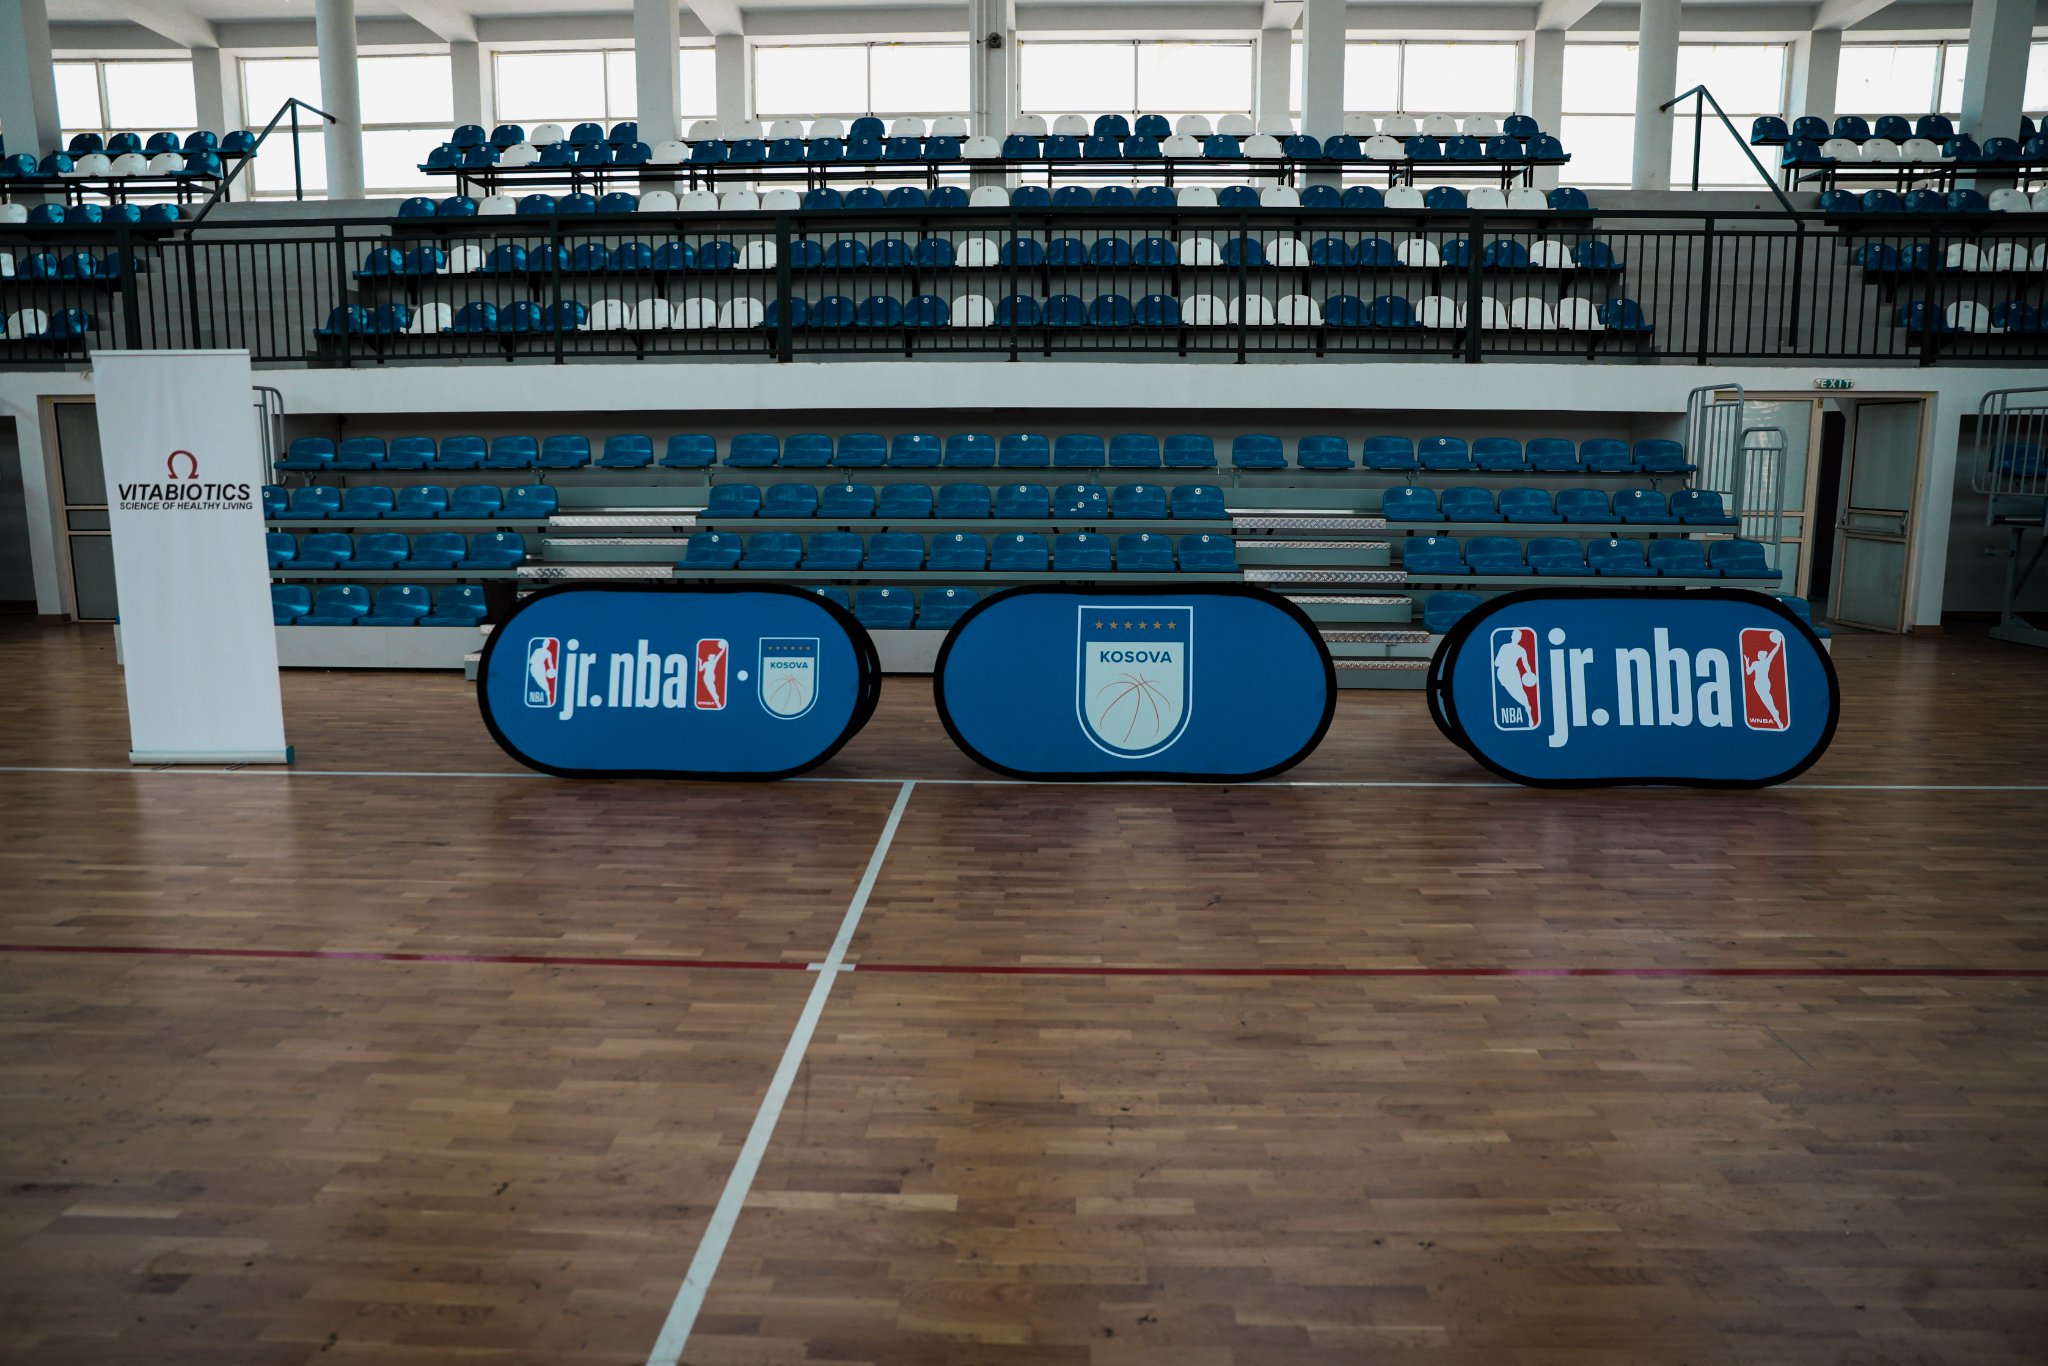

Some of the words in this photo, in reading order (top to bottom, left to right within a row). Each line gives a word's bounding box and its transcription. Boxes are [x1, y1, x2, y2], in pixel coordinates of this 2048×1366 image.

[1821, 380, 1849, 388] EXIT
[118, 484, 251, 501] VITABIOTICS
[120, 502, 159, 510] SCIENCE
[162, 502, 175, 510] OF
[177, 502, 220, 510] HEALTHY
[222, 502, 253, 510] LIVING
[1100, 651, 1172, 663] KOSOVA
[529, 691, 545, 703] NBA
[1501, 707, 1524, 724] NBA
